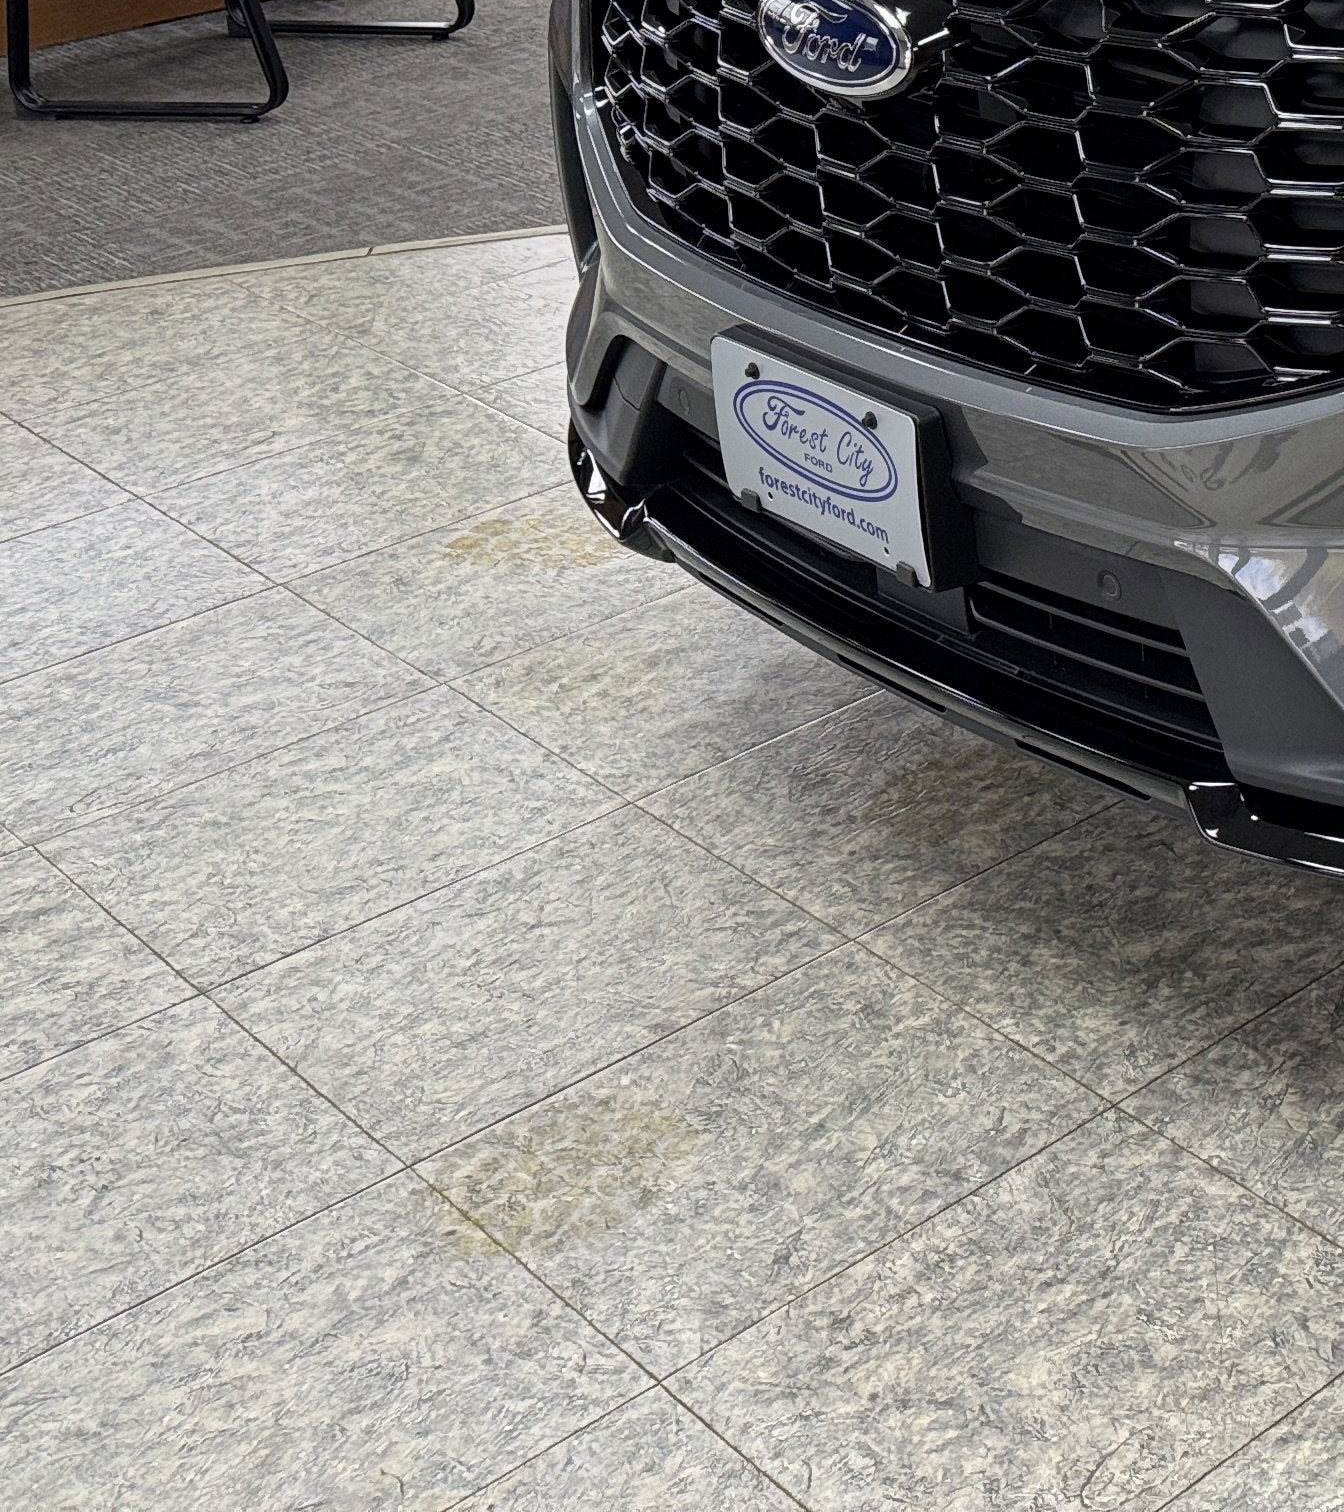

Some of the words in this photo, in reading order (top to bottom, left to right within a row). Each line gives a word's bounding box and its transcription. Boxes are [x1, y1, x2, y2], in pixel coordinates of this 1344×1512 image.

[781, 1, 878, 74] Ford
[762, 395, 829, 453] Forest
[836, 431, 874, 488] City
[803, 453, 833, 473] FORD
[758, 466, 890, 544] forestcityford.com
